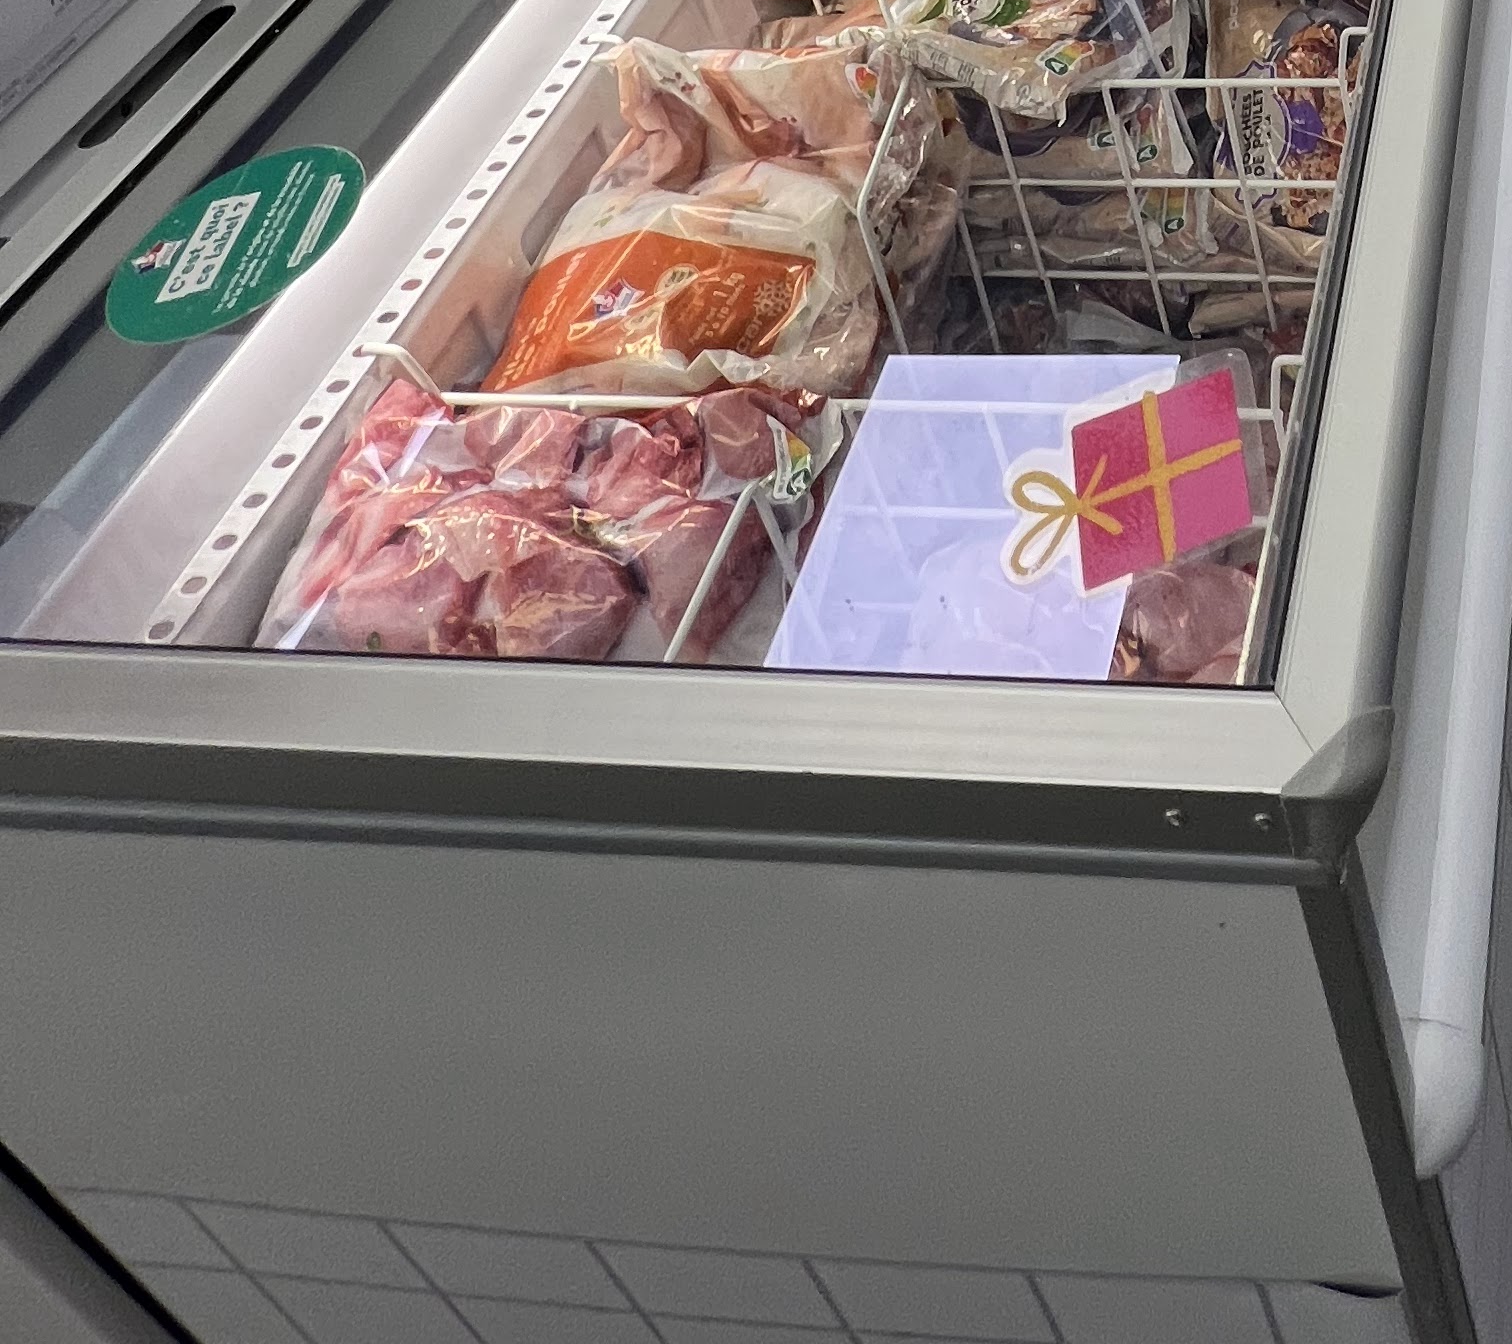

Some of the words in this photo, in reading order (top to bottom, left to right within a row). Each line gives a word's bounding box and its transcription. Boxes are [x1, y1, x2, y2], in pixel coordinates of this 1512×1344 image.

[168, 244, 206, 294] C'est
[200, 203, 229, 242] quoi
[196, 263, 216, 286] ce
[206, 213, 242, 261] label
